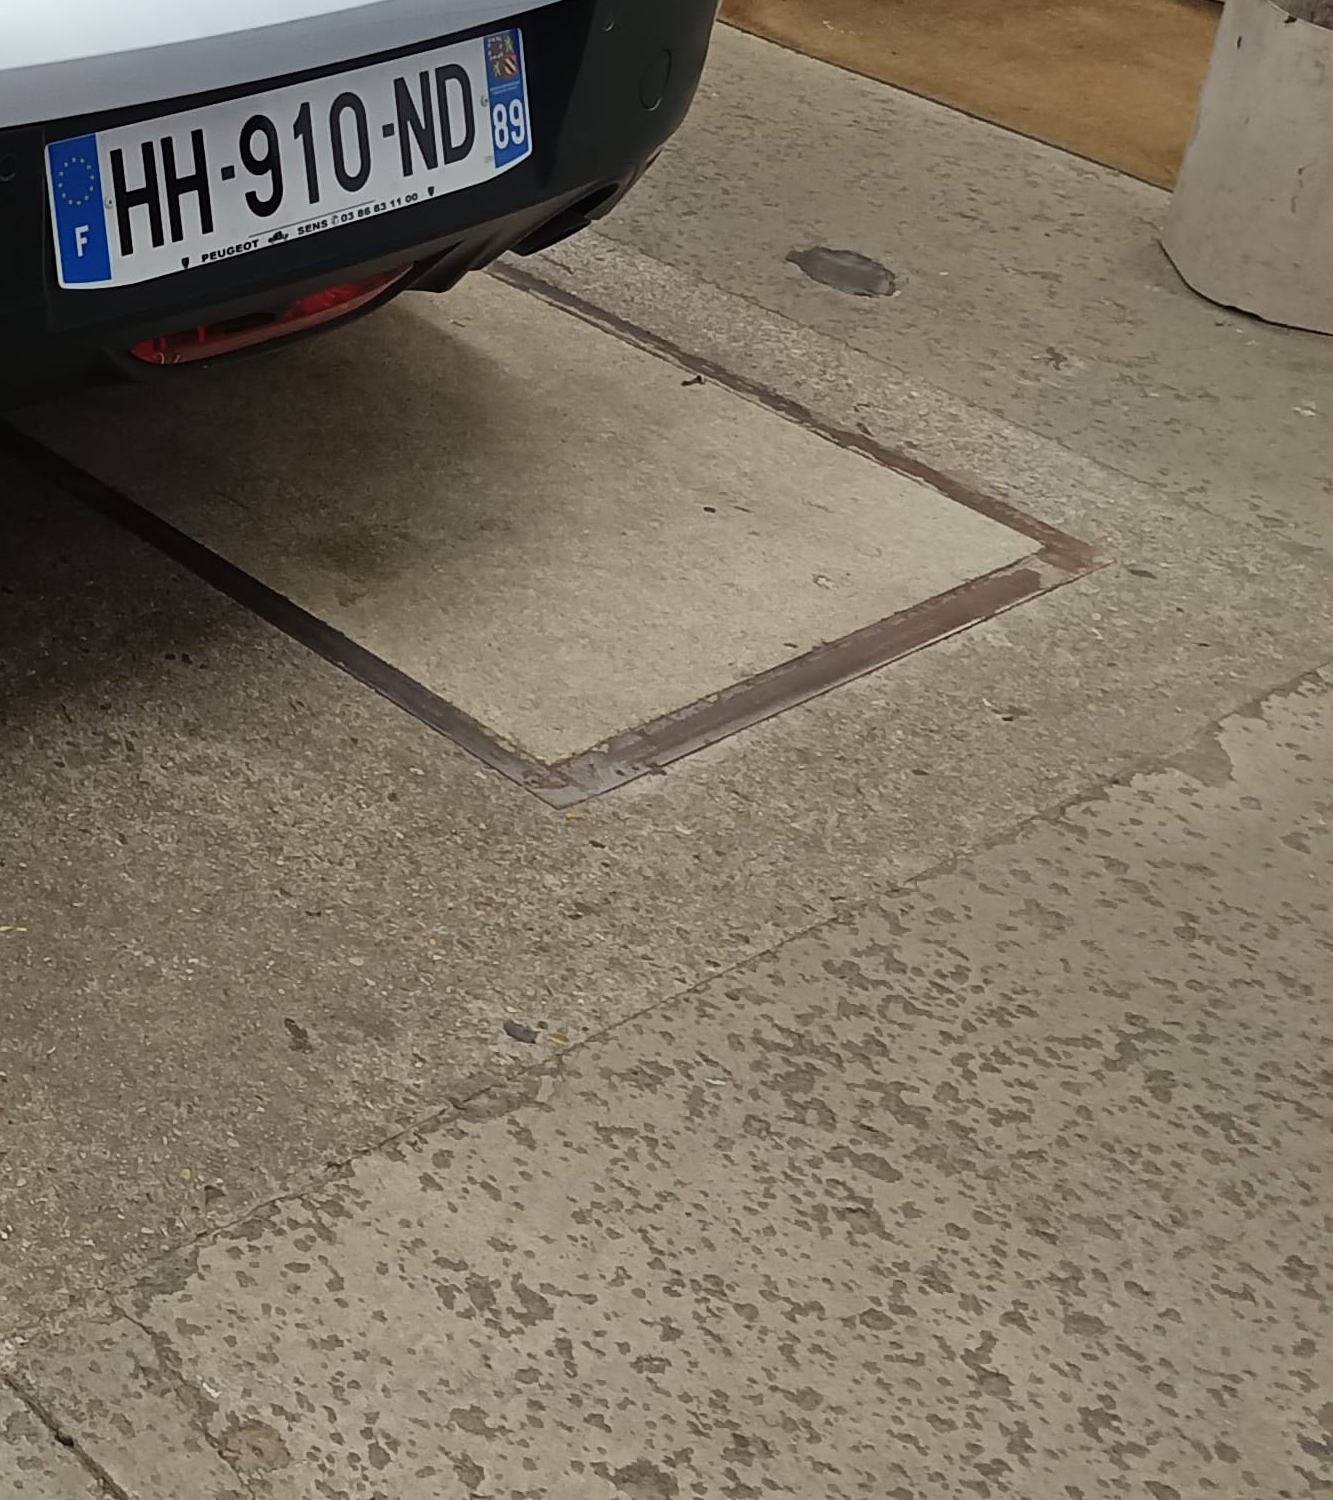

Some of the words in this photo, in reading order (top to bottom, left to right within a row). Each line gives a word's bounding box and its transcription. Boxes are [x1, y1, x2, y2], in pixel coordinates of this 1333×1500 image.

[492, 98, 526, 150] 89
[110, 63, 476, 257] HH-910-ND
[74, 224, 90, 257] F
[201, 239, 260, 263] PEUGEOT
[297, 219, 329, 236] SENS
